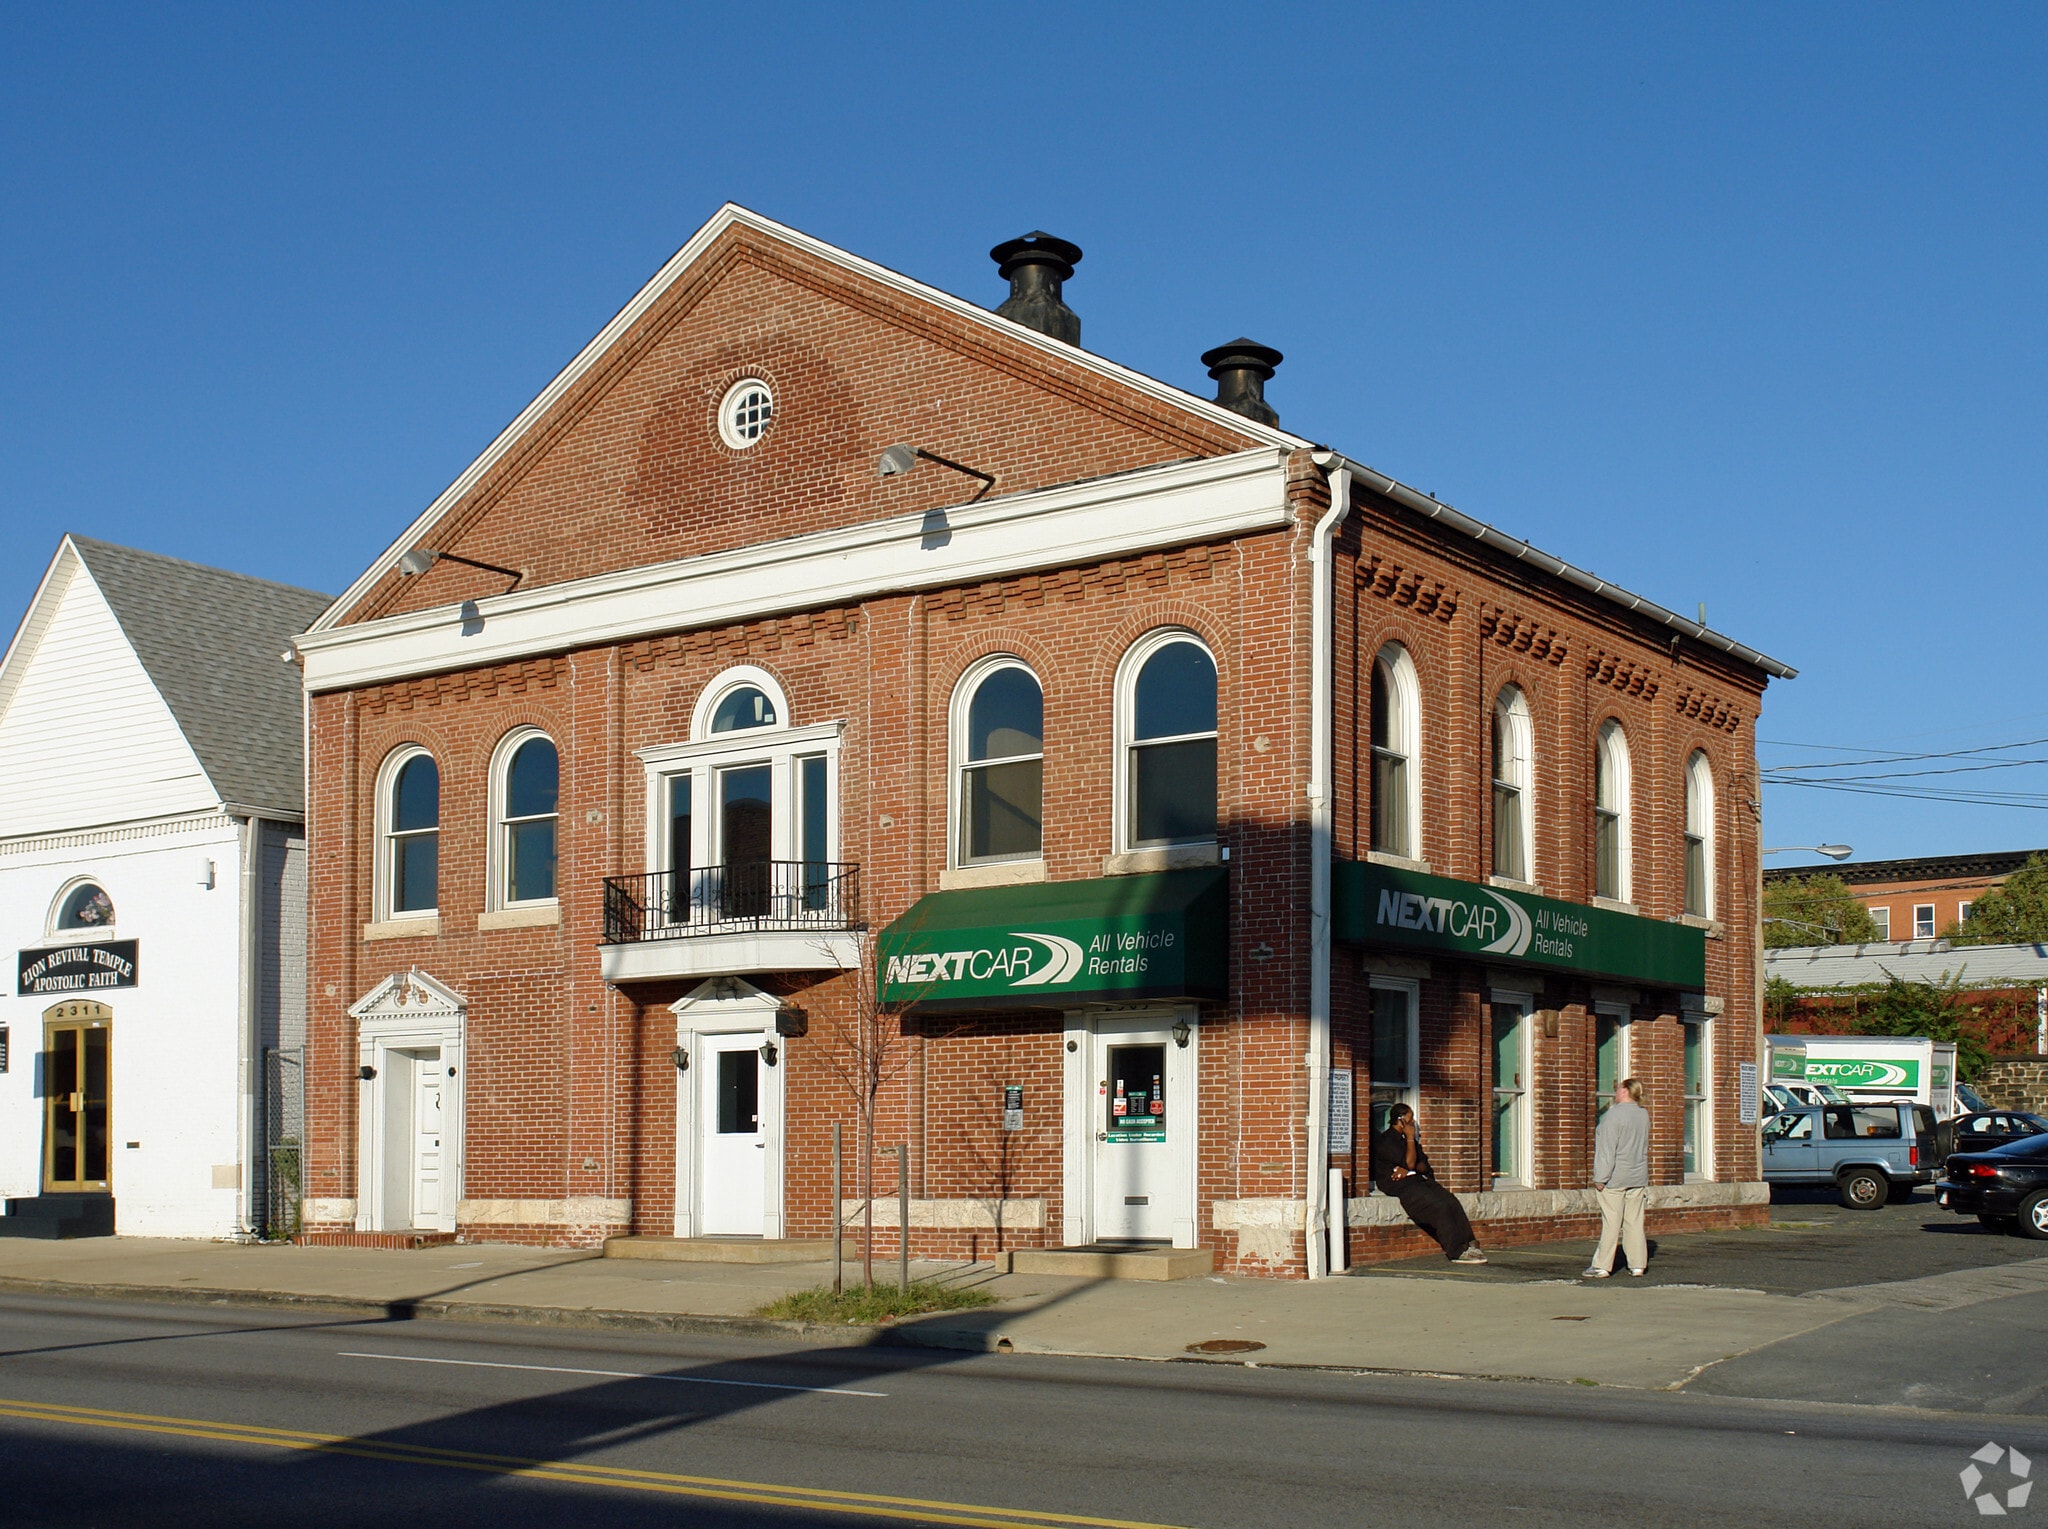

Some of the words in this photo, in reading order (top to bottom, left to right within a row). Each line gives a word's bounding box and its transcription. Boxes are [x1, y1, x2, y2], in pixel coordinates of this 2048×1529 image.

[1376, 888, 1498, 941] NEXTCAR
[1535, 908, 1549, 930] All
[1552, 911, 1588, 937] Vehicle
[1089, 933, 1111, 953] All
[1116, 929, 1175, 951] Vehicle
[1535, 933, 1573, 958] Rentals
[22, 958, 46, 986] ZION
[47, 947, 89, 969] REVIVAL
[92, 948, 133, 977] TEMPLE
[885, 947, 1033, 984] NEXTCAR
[1088, 954, 1149, 975] Rentals
[33, 974, 86, 992] APOSTOLIC
[88, 971, 118, 987] FAITH
[57, 1004, 100, 1017] 2311
[1805, 1063, 1874, 1076] EXTCAR
[1811, 1077, 1838, 1085] Rentals
